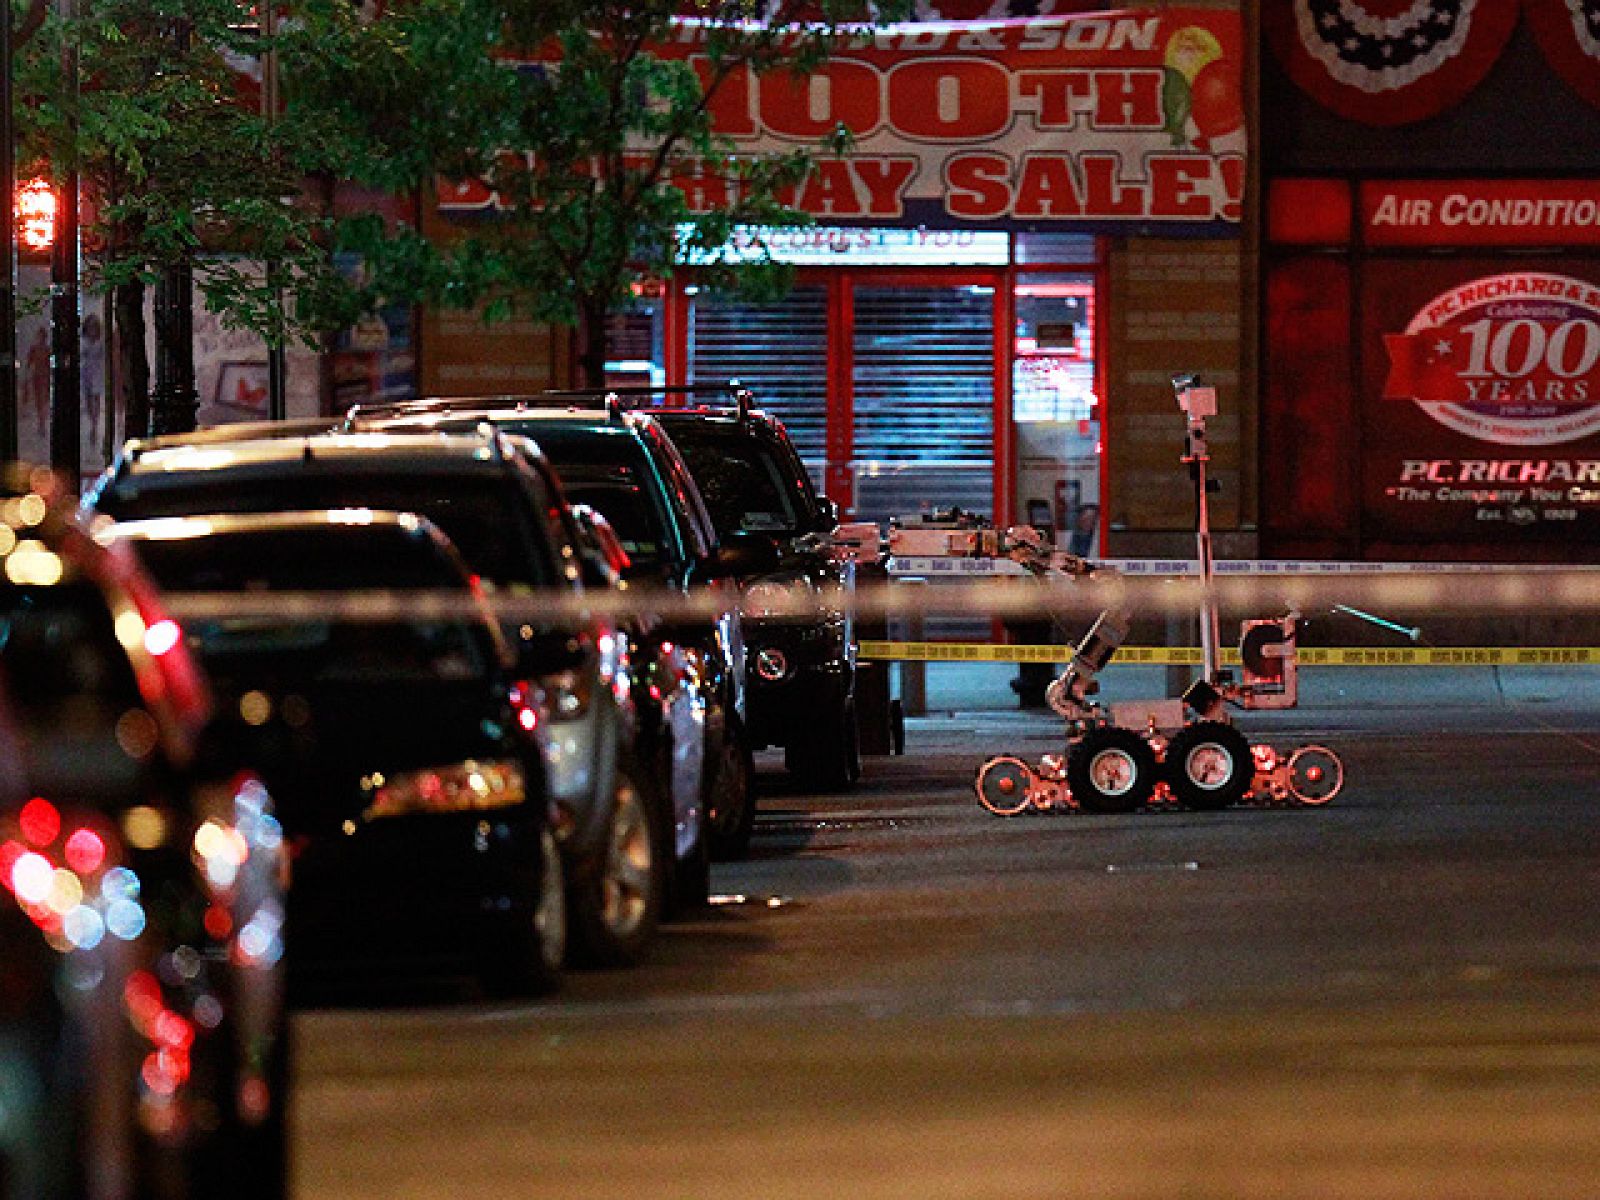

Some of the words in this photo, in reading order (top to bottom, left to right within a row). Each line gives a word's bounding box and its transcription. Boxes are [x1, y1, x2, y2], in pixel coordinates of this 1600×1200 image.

[1018, 18, 1160, 51] SON
[945, 153, 1243, 219] SALE!
[1371, 194, 1432, 226] AIR
[1439, 194, 1600, 226] CONDITIO
[1456, 318, 1600, 378] 100
[1464, 379, 1589, 401] YEARS
[1459, 459, 1600, 483] RICHAR
